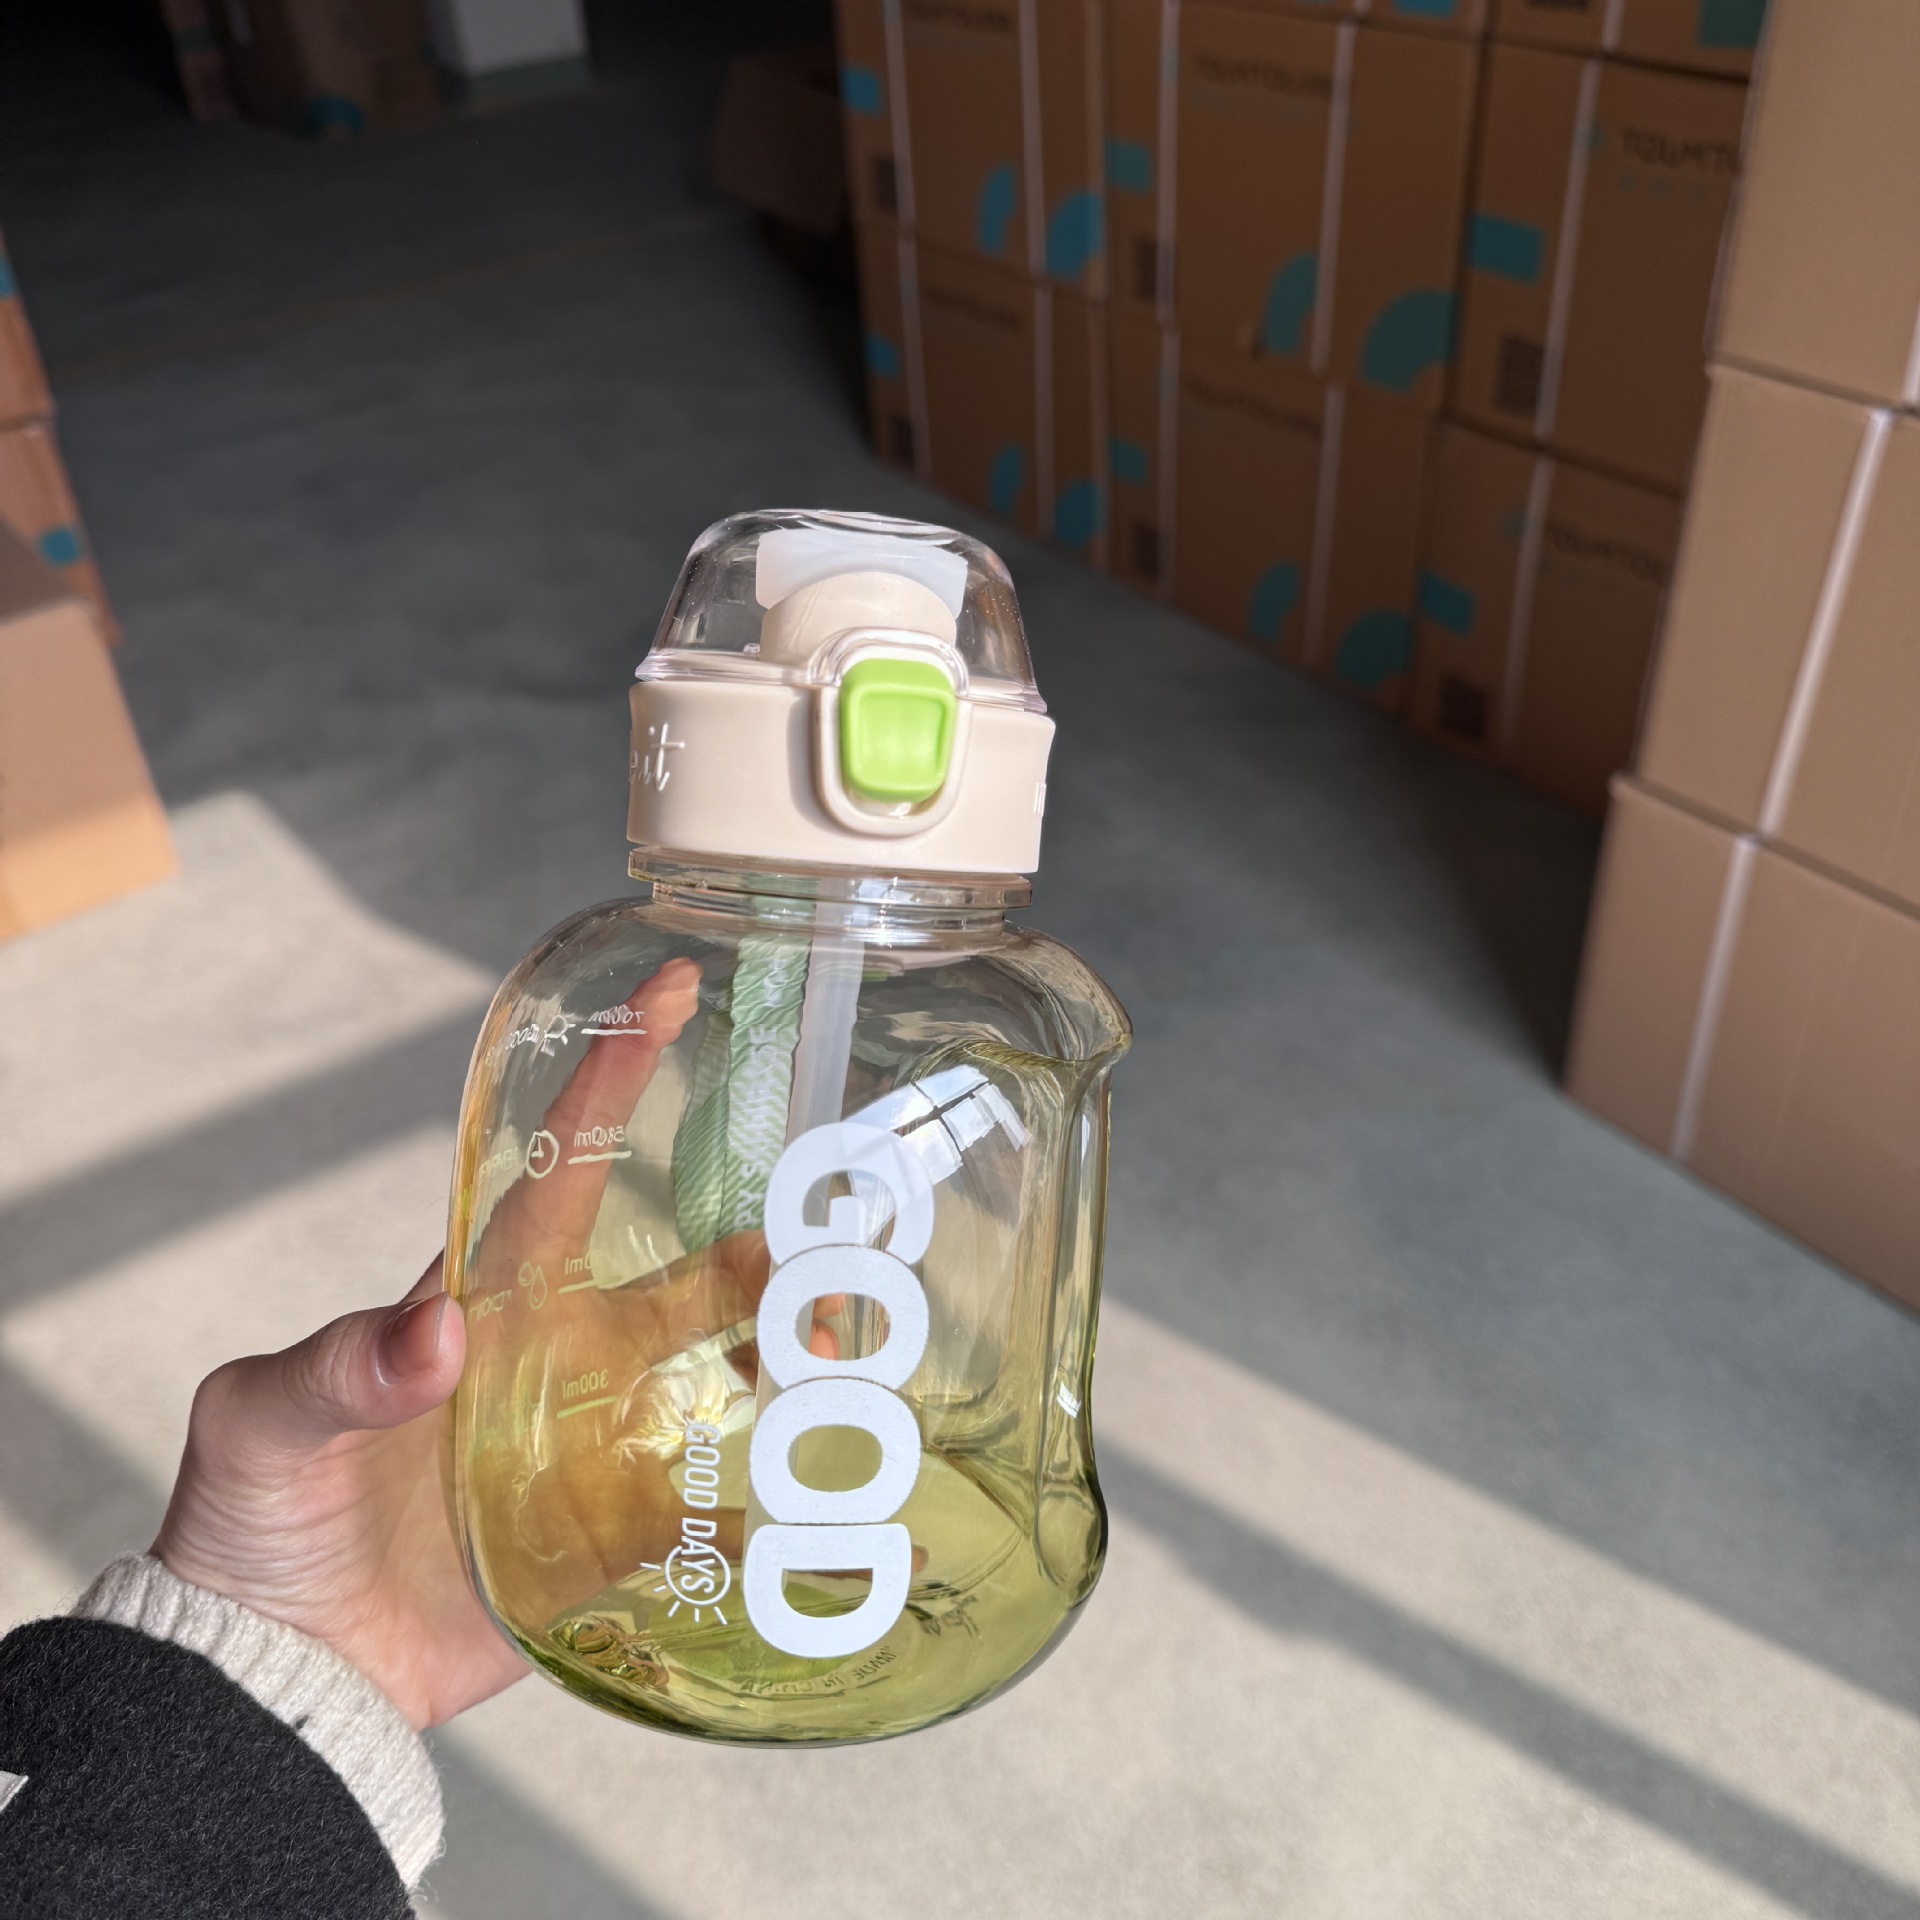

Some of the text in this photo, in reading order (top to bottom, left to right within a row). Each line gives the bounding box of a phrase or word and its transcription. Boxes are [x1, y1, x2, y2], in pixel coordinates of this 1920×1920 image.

[680, 1423, 722, 1594] GOOD DAYS
[744, 1121, 935, 1659] GOOD
